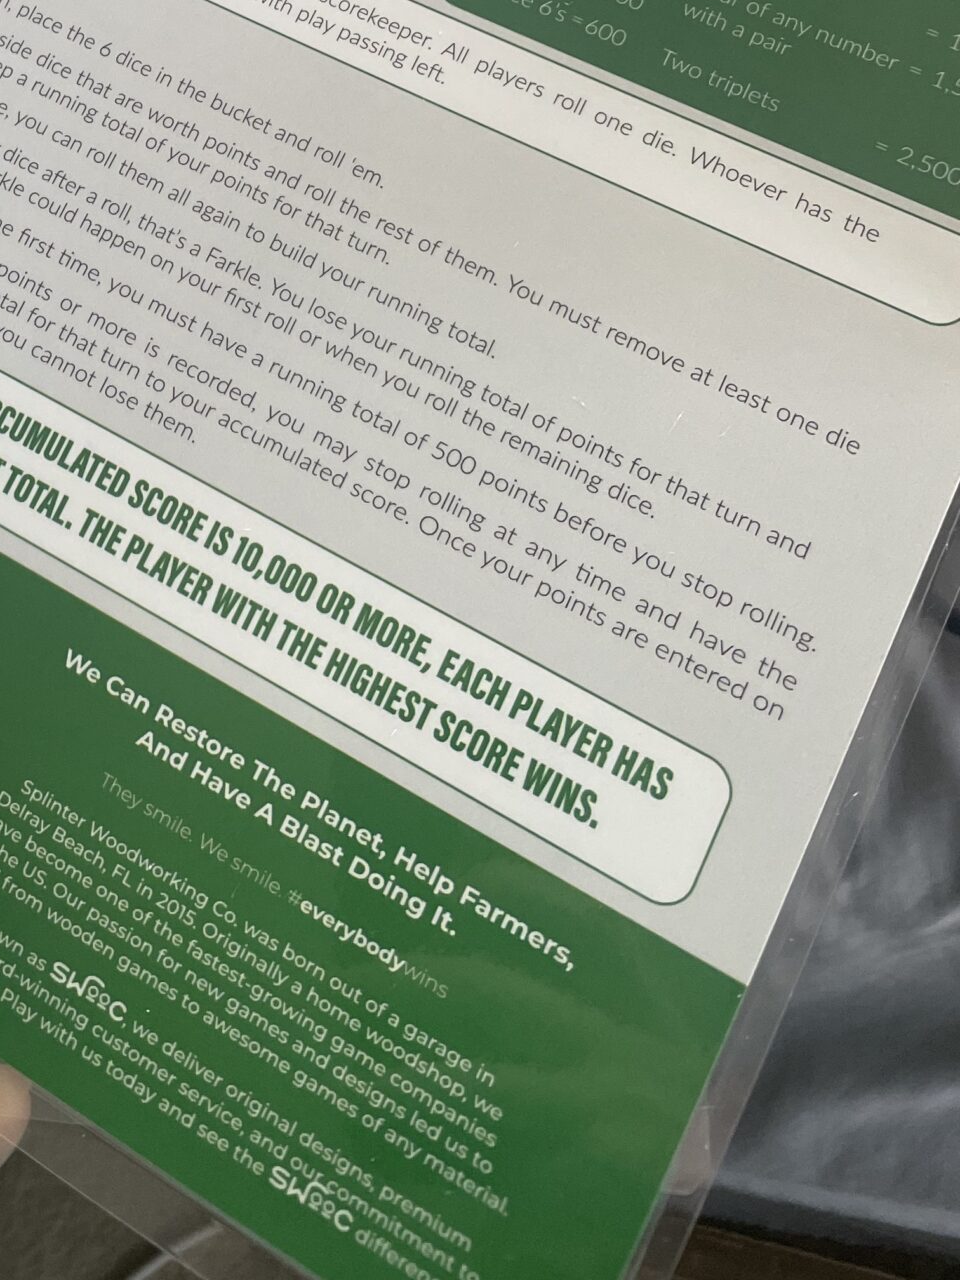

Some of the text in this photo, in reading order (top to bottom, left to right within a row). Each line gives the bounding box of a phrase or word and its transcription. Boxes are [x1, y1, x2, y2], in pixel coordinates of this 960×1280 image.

[294, 8, 336, 36] play
[336, 27, 408, 69] passing
[410, 55, 445, 85] left.
[2, 464, 73, 530] TOTAL.
[78, 507, 128, 556] THE
[121, 534, 214, 606] PLAYER
[211, 583, 279, 642] WITH
[276, 619, 328, 670] THE
[322, 647, 439, 731] HIGHEST
[433, 710, 525, 783] SCORE
[522, 757, 598, 829] WINS.
[127, 479, 209, 543] SCORE
[203, 520, 235, 556] IS
[231, 536, 318, 603] 10,000
[315, 583, 356, 625] OR
[352, 602, 433, 674] MORE,
[436, 648, 513, 712] EACH
[507, 688, 614, 769] PLAYER
[611, 744, 674, 801] HAS
[65, 648, 574, 972] We Can Restore The Planet, Help Farmers,
[103, 773, 140, 809] They
[143, 803, 191, 839] smile.
[200, 833, 228, 862] We
[233, 857, 281, 894] smile.
[135, 731, 456, 936] And Have A Blast Doing It.
